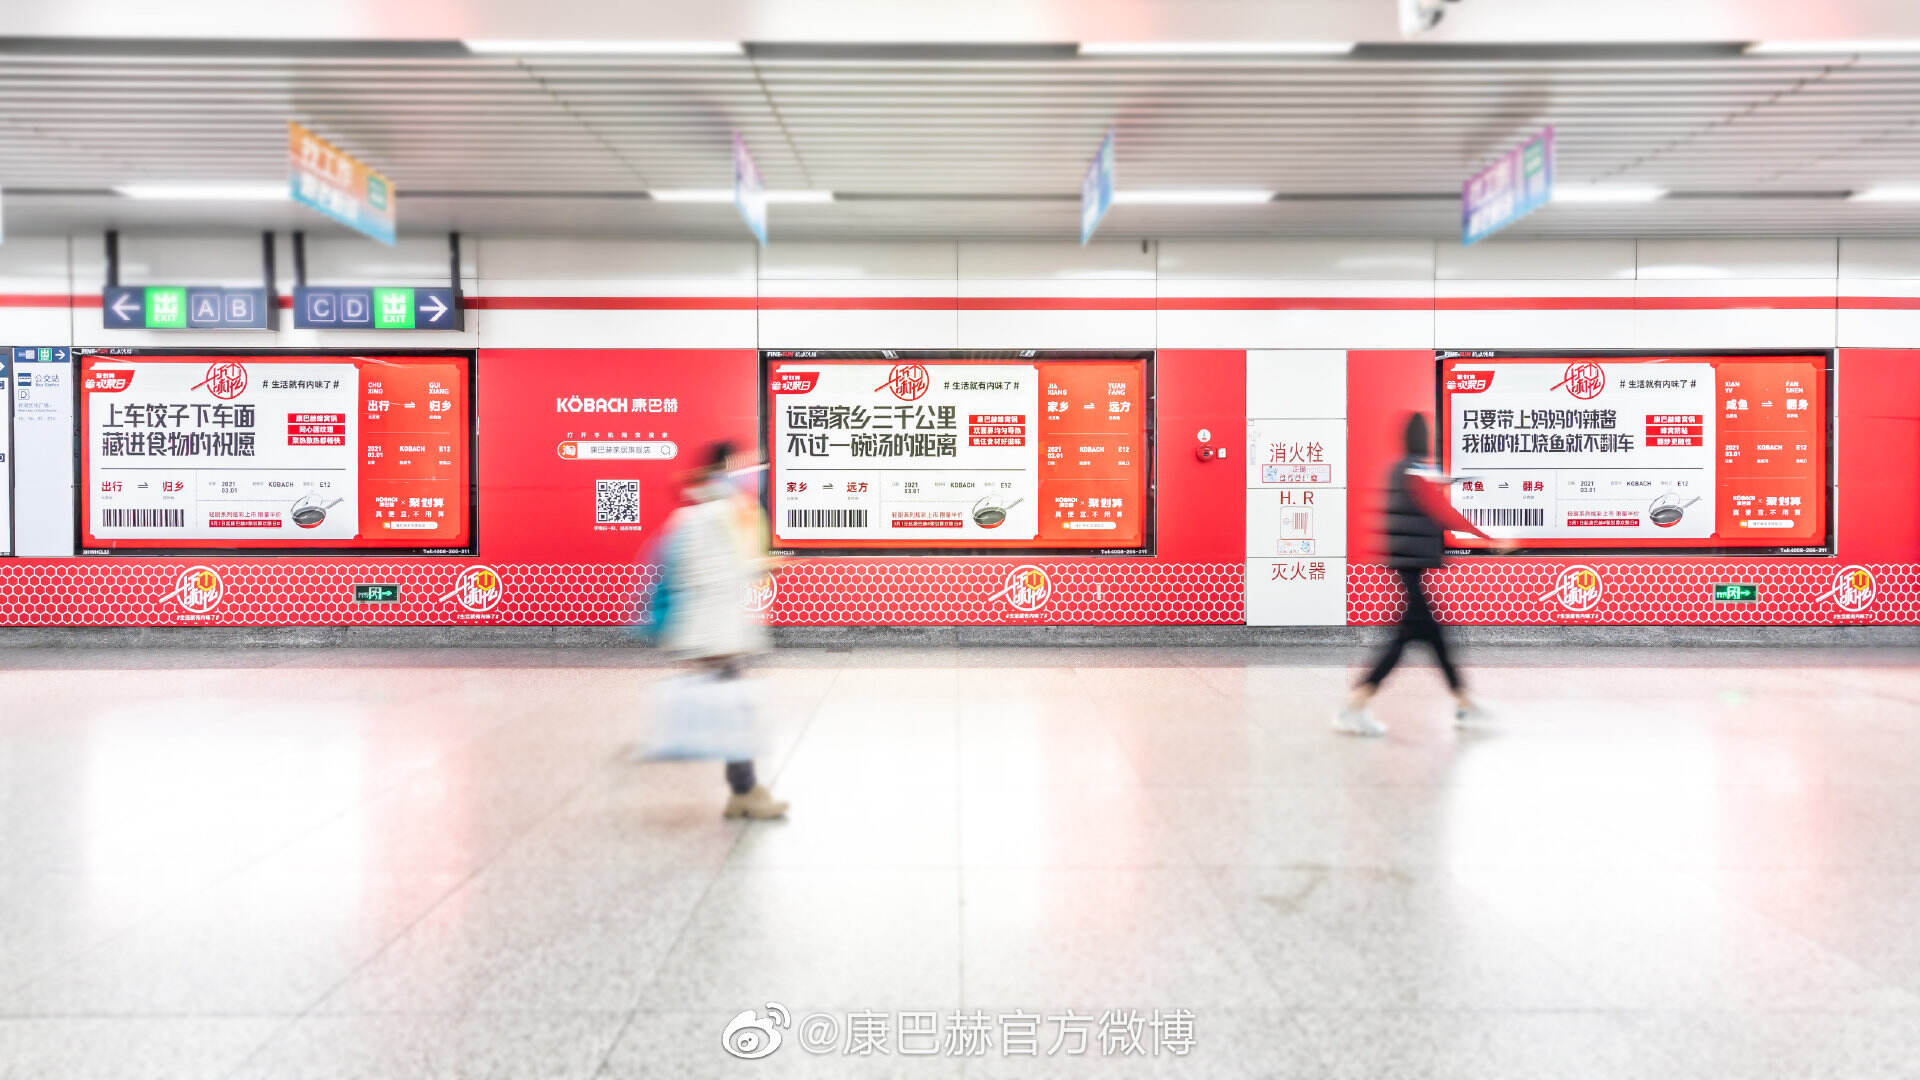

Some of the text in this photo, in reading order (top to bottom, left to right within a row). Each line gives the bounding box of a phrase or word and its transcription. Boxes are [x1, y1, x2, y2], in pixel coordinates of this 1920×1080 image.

[198, 299, 247, 317] A B
[314, 299, 362, 317] C D
[154, 314, 177, 322] EXIT
[383, 315, 406, 323] EXIT
[272, 380, 331, 389] 生活就有内味了
[952, 381, 1012, 390] 生活就有内味了
[1629, 380, 1687, 388] 生活就有内味了
[368, 400, 390, 412] 出行
[429, 400, 452, 412] 归乡
[557, 395, 678, 412] KÖBACH 康巴赫
[1048, 401, 1069, 412] 家乡
[1109, 401, 1131, 412] 远方
[1726, 399, 1748, 410] 咸鱼
[1786, 399, 1808, 410] 翻身
[102, 403, 255, 428] 上车饺子下车面
[786, 405, 956, 429] 远离家乡三千公里
[1463, 410, 1616, 429] 只要带上妈妈的辣酱
[102, 432, 255, 456] 藏进食物的祝愿
[786, 433, 957, 457] 不过一碗汤的距离
[1462, 434, 1634, 453] 我做的红烧鱼就不翻车
[1270, 442, 1324, 463] 消火栓
[101, 481, 122, 492] 出行
[163, 481, 184, 492] 归乡
[786, 481, 807, 492] 家乡
[847, 481, 868, 492] 远方
[1462, 481, 1484, 492] 咸鱼
[1523, 481, 1544, 492] 翻身
[409, 498, 444, 508] 聚划算
[1088, 498, 1123, 508] 聚划算
[1280, 491, 1314, 504] H. R
[1766, 496, 1802, 506] 聚划算
[1272, 562, 1325, 581] 灭火器
